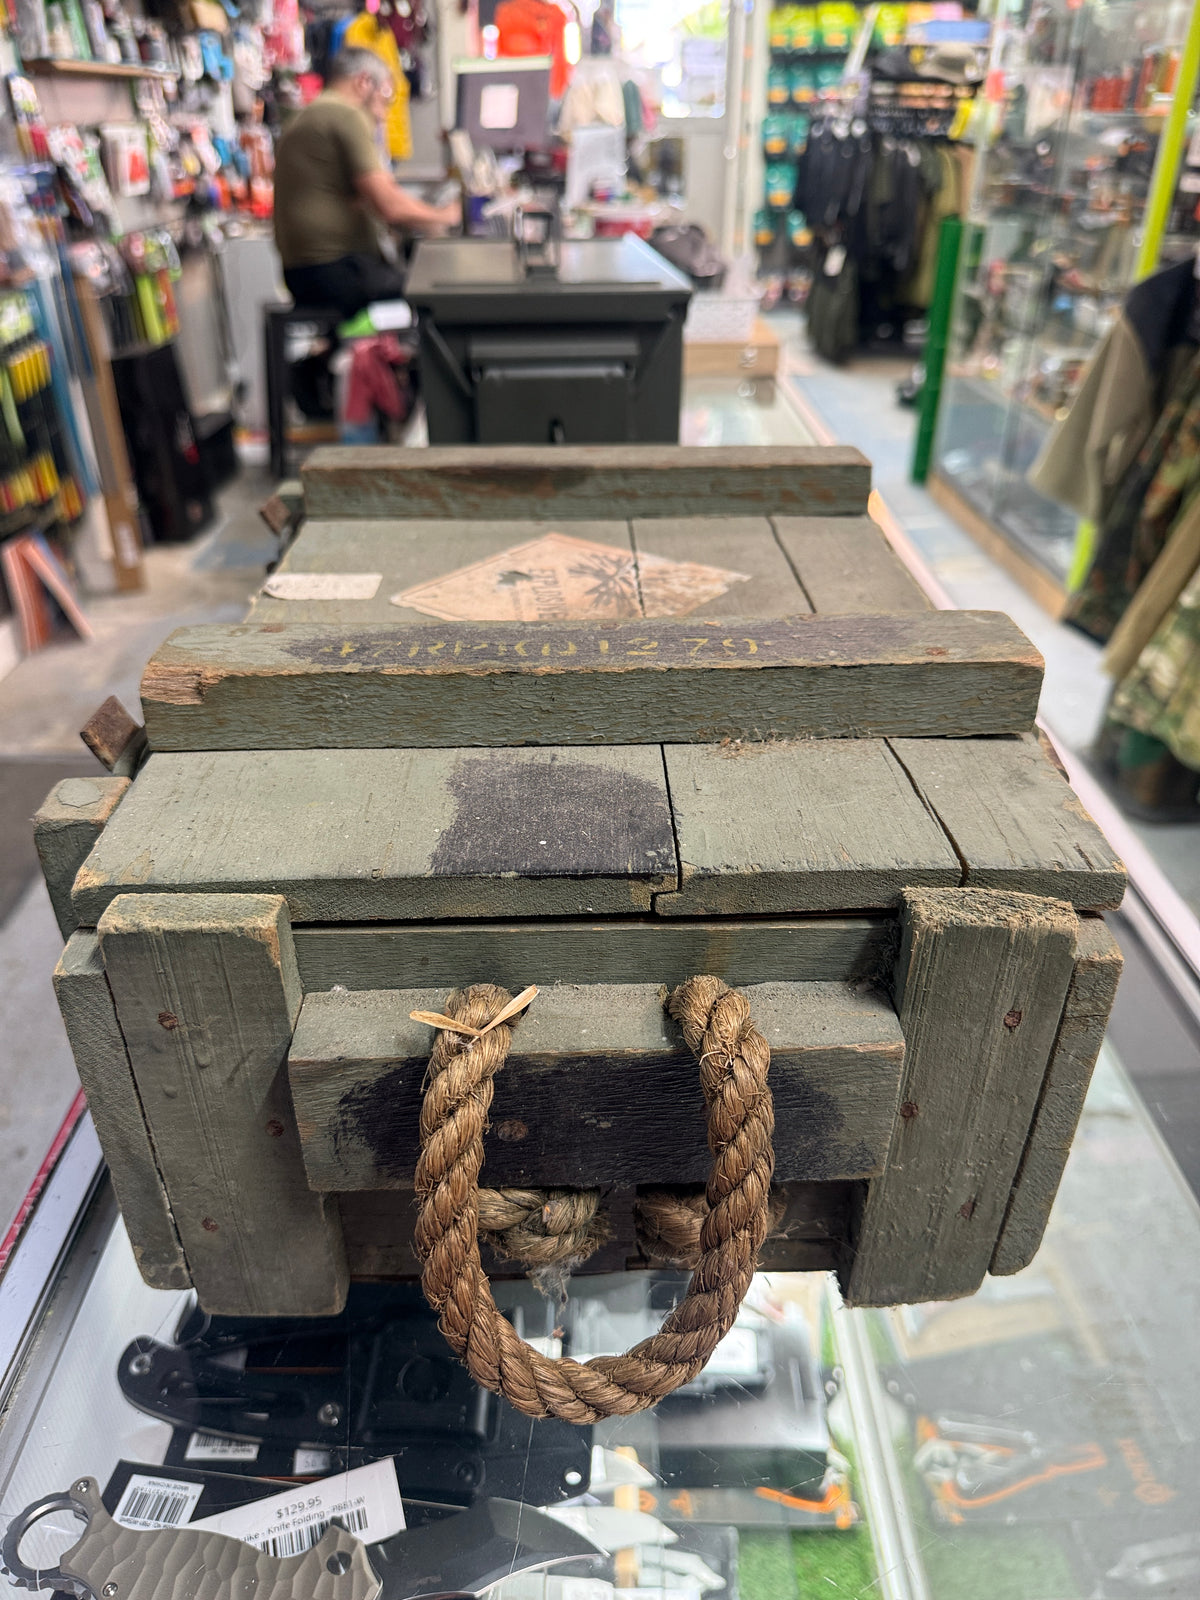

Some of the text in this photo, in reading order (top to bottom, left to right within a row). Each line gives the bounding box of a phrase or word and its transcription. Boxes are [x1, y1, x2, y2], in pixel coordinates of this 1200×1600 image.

[276, 1495, 322, 1519] $129.95
[267, 1521, 291, 1535] Knife
[292, 1511, 325, 1527] Folding
